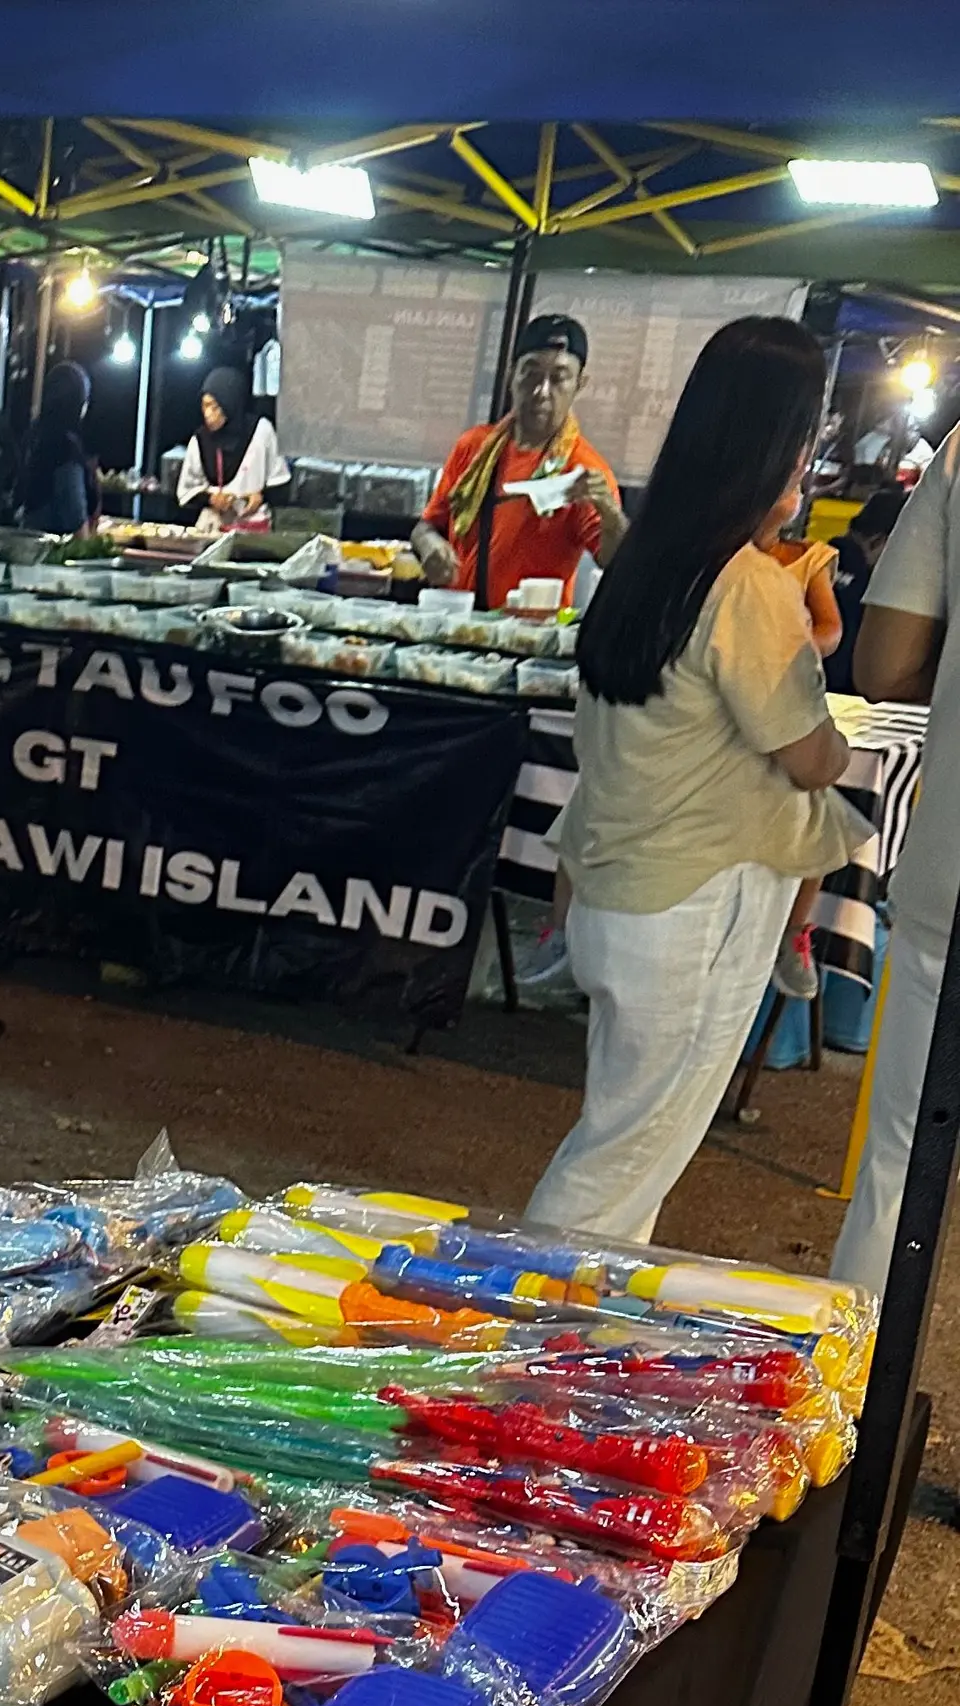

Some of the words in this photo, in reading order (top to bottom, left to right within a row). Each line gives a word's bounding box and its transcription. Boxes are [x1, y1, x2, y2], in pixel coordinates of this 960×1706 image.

[207, 669, 390, 736] FOO
[13, 729, 118, 791] GT
[140, 844, 469, 948] ISLAND
